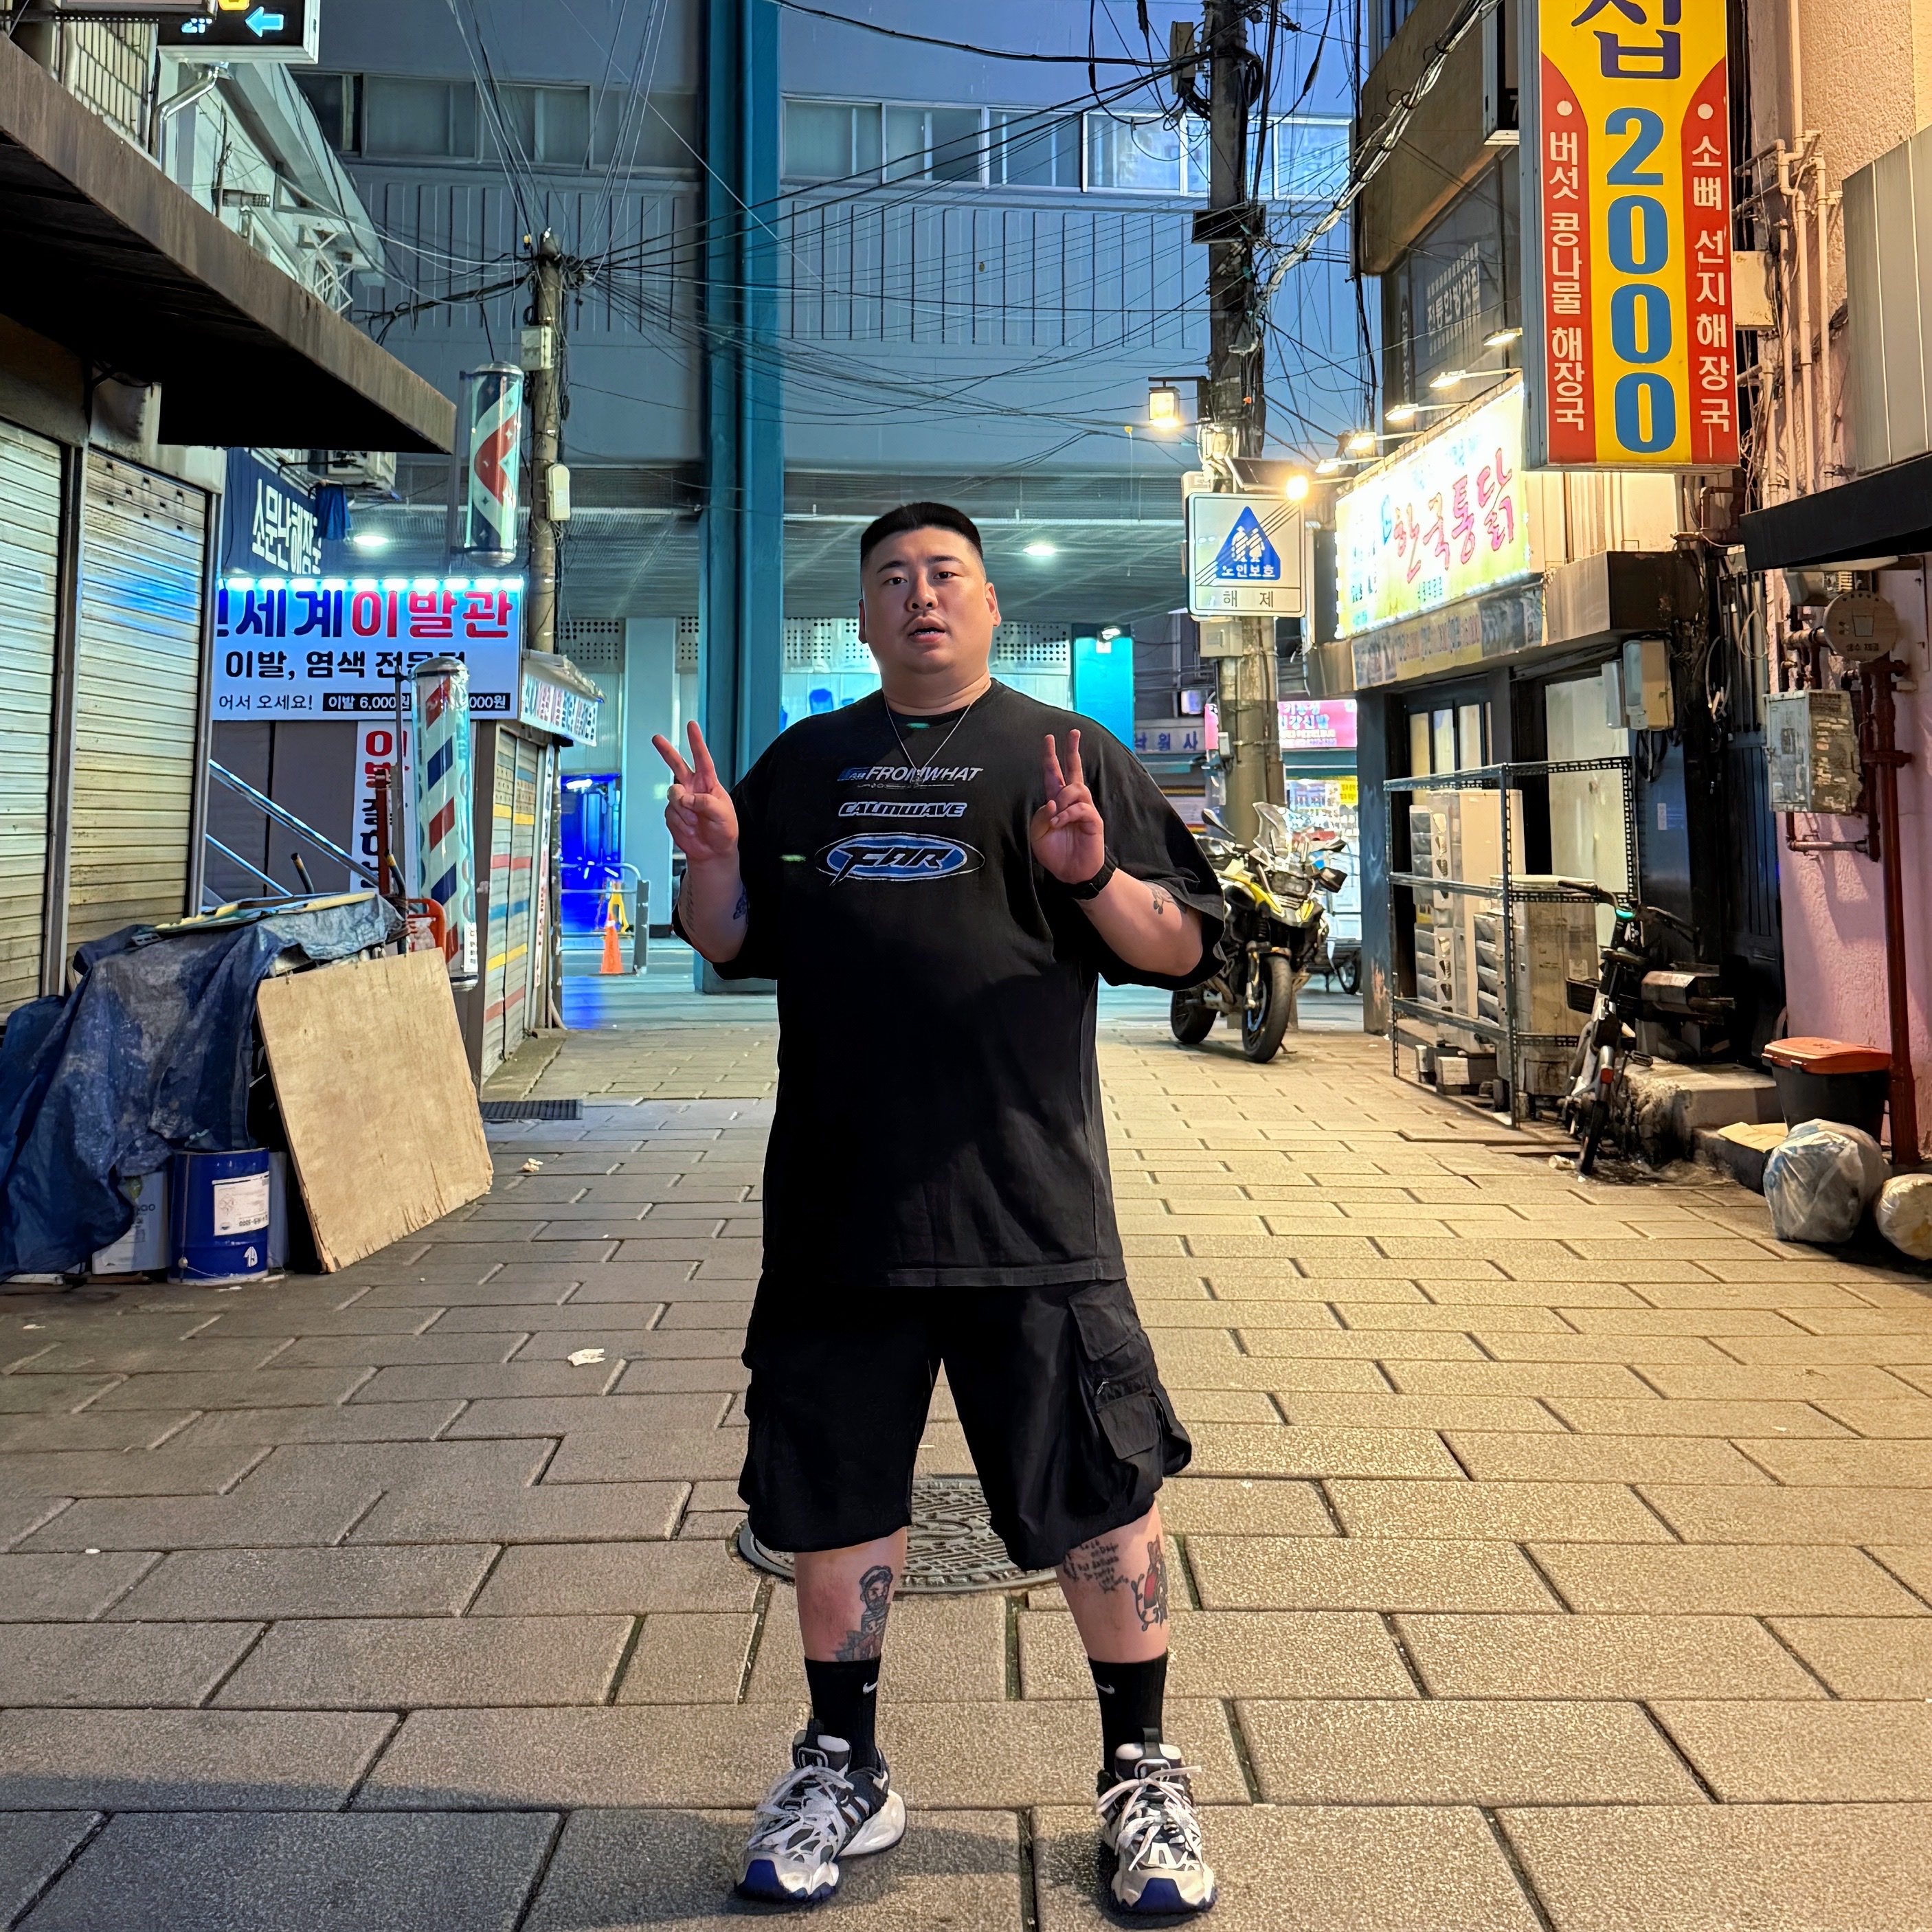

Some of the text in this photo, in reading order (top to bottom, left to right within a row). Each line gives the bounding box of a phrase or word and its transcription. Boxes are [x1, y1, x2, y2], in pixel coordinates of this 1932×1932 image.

[1549, 131, 1585, 431] 버섯 콩나물 해장국
[1604, 106, 1677, 454] 2000
[1393, 447, 1514, 584] 한국통닭
[1221, 563, 1276, 578] 노인보호
[219, 695, 251, 710] 어서
[257, 695, 313, 710] 오세요!
[328, 695, 355, 710] 이발
[226, 651, 295, 680] 이발,
[306, 651, 365, 678] 염색
